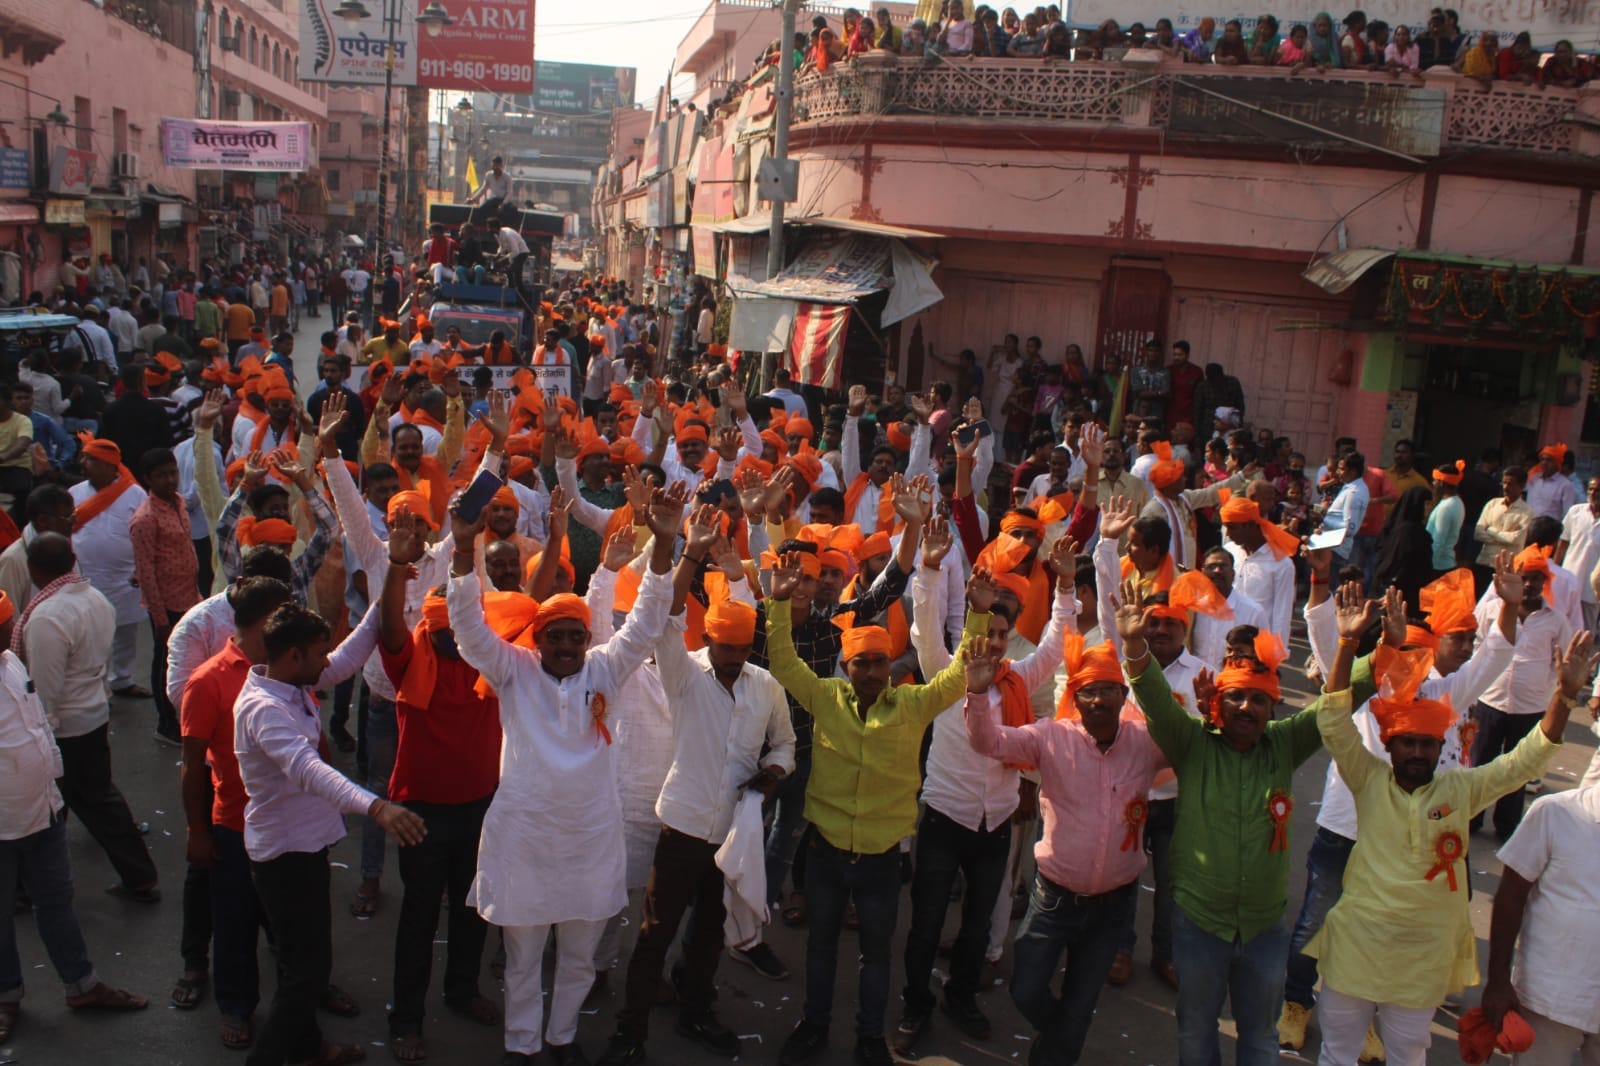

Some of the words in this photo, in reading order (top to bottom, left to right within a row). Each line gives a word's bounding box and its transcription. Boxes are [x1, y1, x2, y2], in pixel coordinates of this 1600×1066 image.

[448, 6, 527, 31] -ARM
[371, 60, 406, 70] CENRE
[420, 58, 532, 82] 911-960-1990
